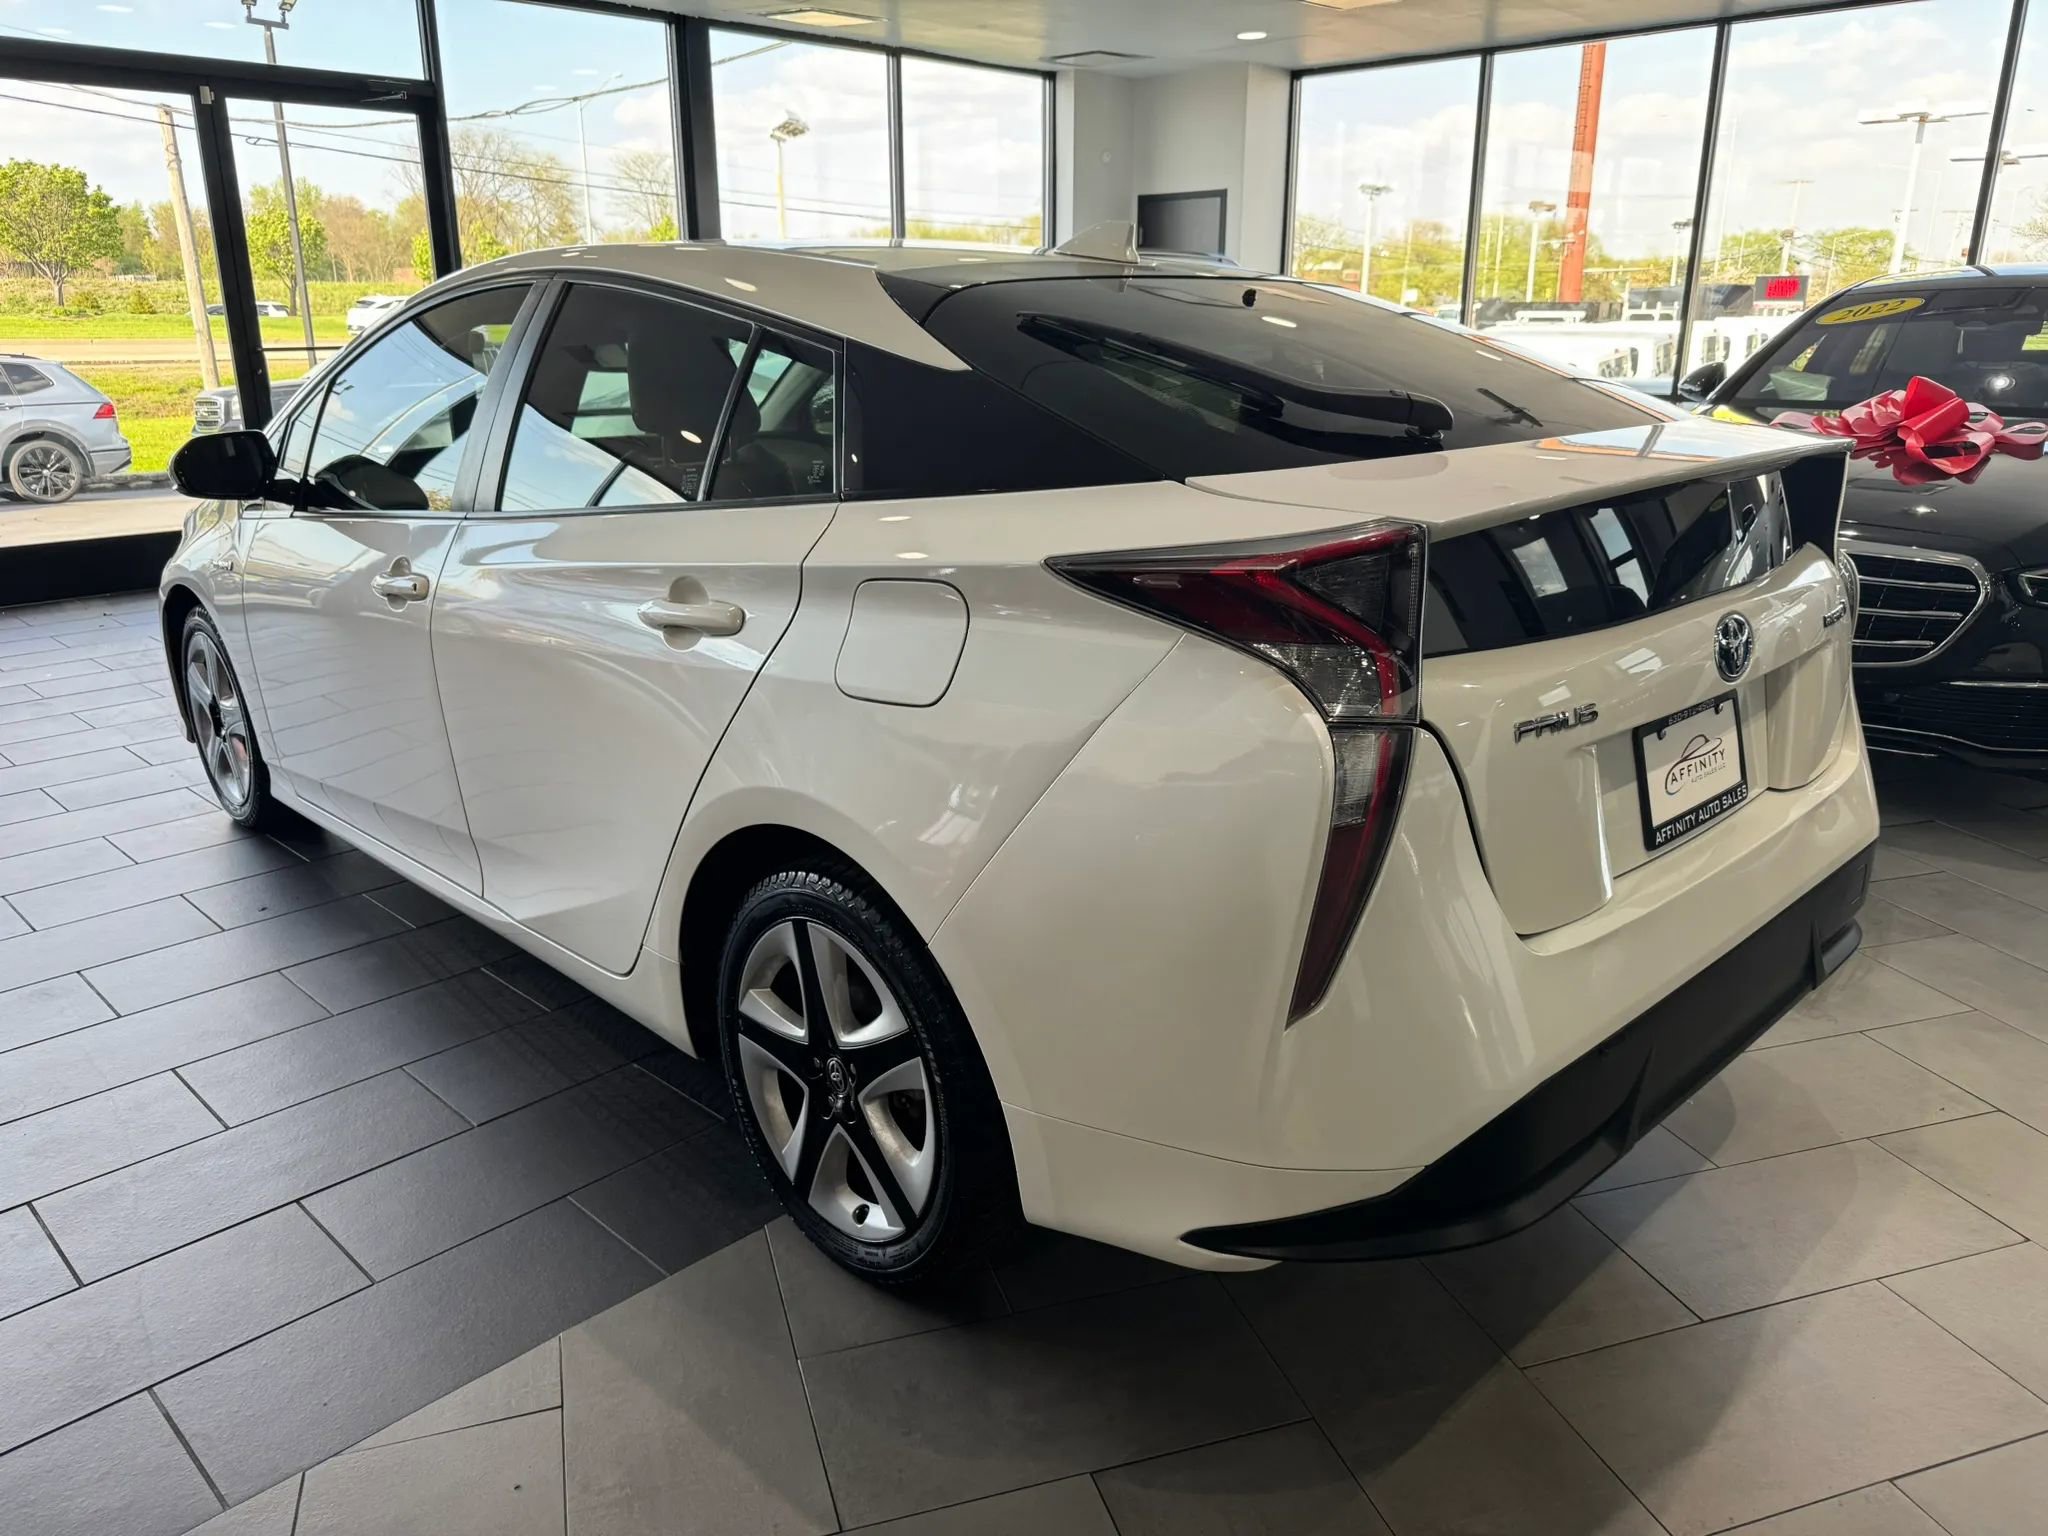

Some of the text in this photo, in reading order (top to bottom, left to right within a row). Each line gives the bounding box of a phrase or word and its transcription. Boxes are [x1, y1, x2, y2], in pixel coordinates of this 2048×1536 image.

[1833, 300, 1906, 322] 2022
[1514, 703, 1599, 744] PRIUS
[1671, 748, 1725, 784] AFFINITY
[1656, 785, 1747, 845] AFFINITY AUTO SALES
